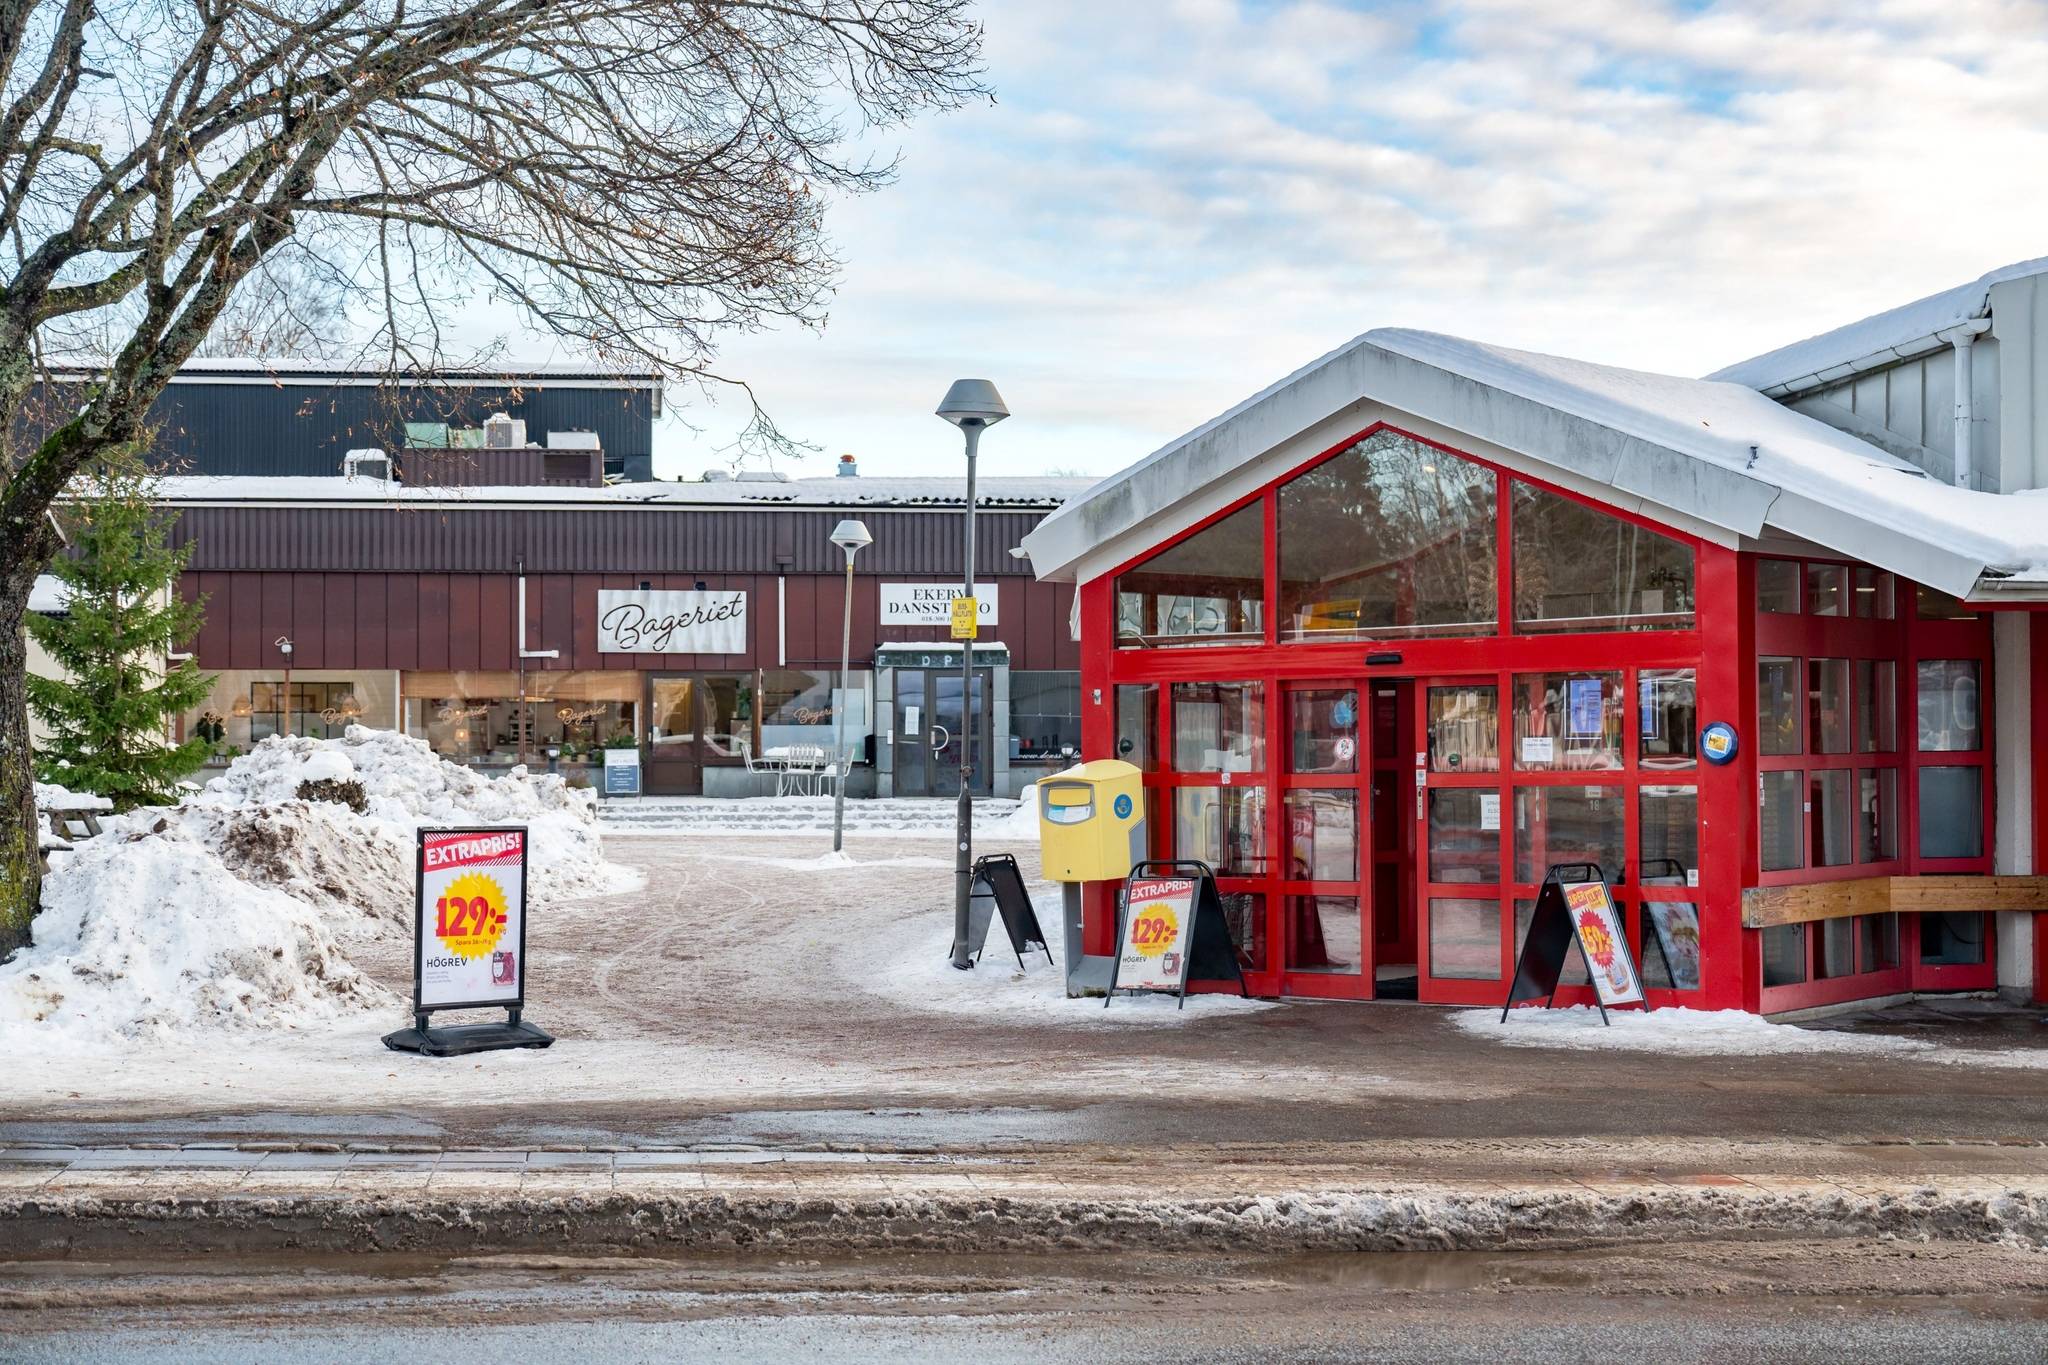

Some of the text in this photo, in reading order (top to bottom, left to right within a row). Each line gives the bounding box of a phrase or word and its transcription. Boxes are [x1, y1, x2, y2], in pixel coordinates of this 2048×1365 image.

[889, 602, 991, 614] DANSSTO
[601, 592, 743, 652] Bageriet
[557, 704, 607, 725] Bageriet
[793, 705, 842, 725] Bageri
[426, 832, 521, 866] EXTRAPRIS!
[1130, 880, 1193, 900] EXTRAPRIS!
[436, 896, 508, 937] 129:-
[1131, 918, 1178, 944] 129:-
[426, 956, 469, 968] HÖGREV
